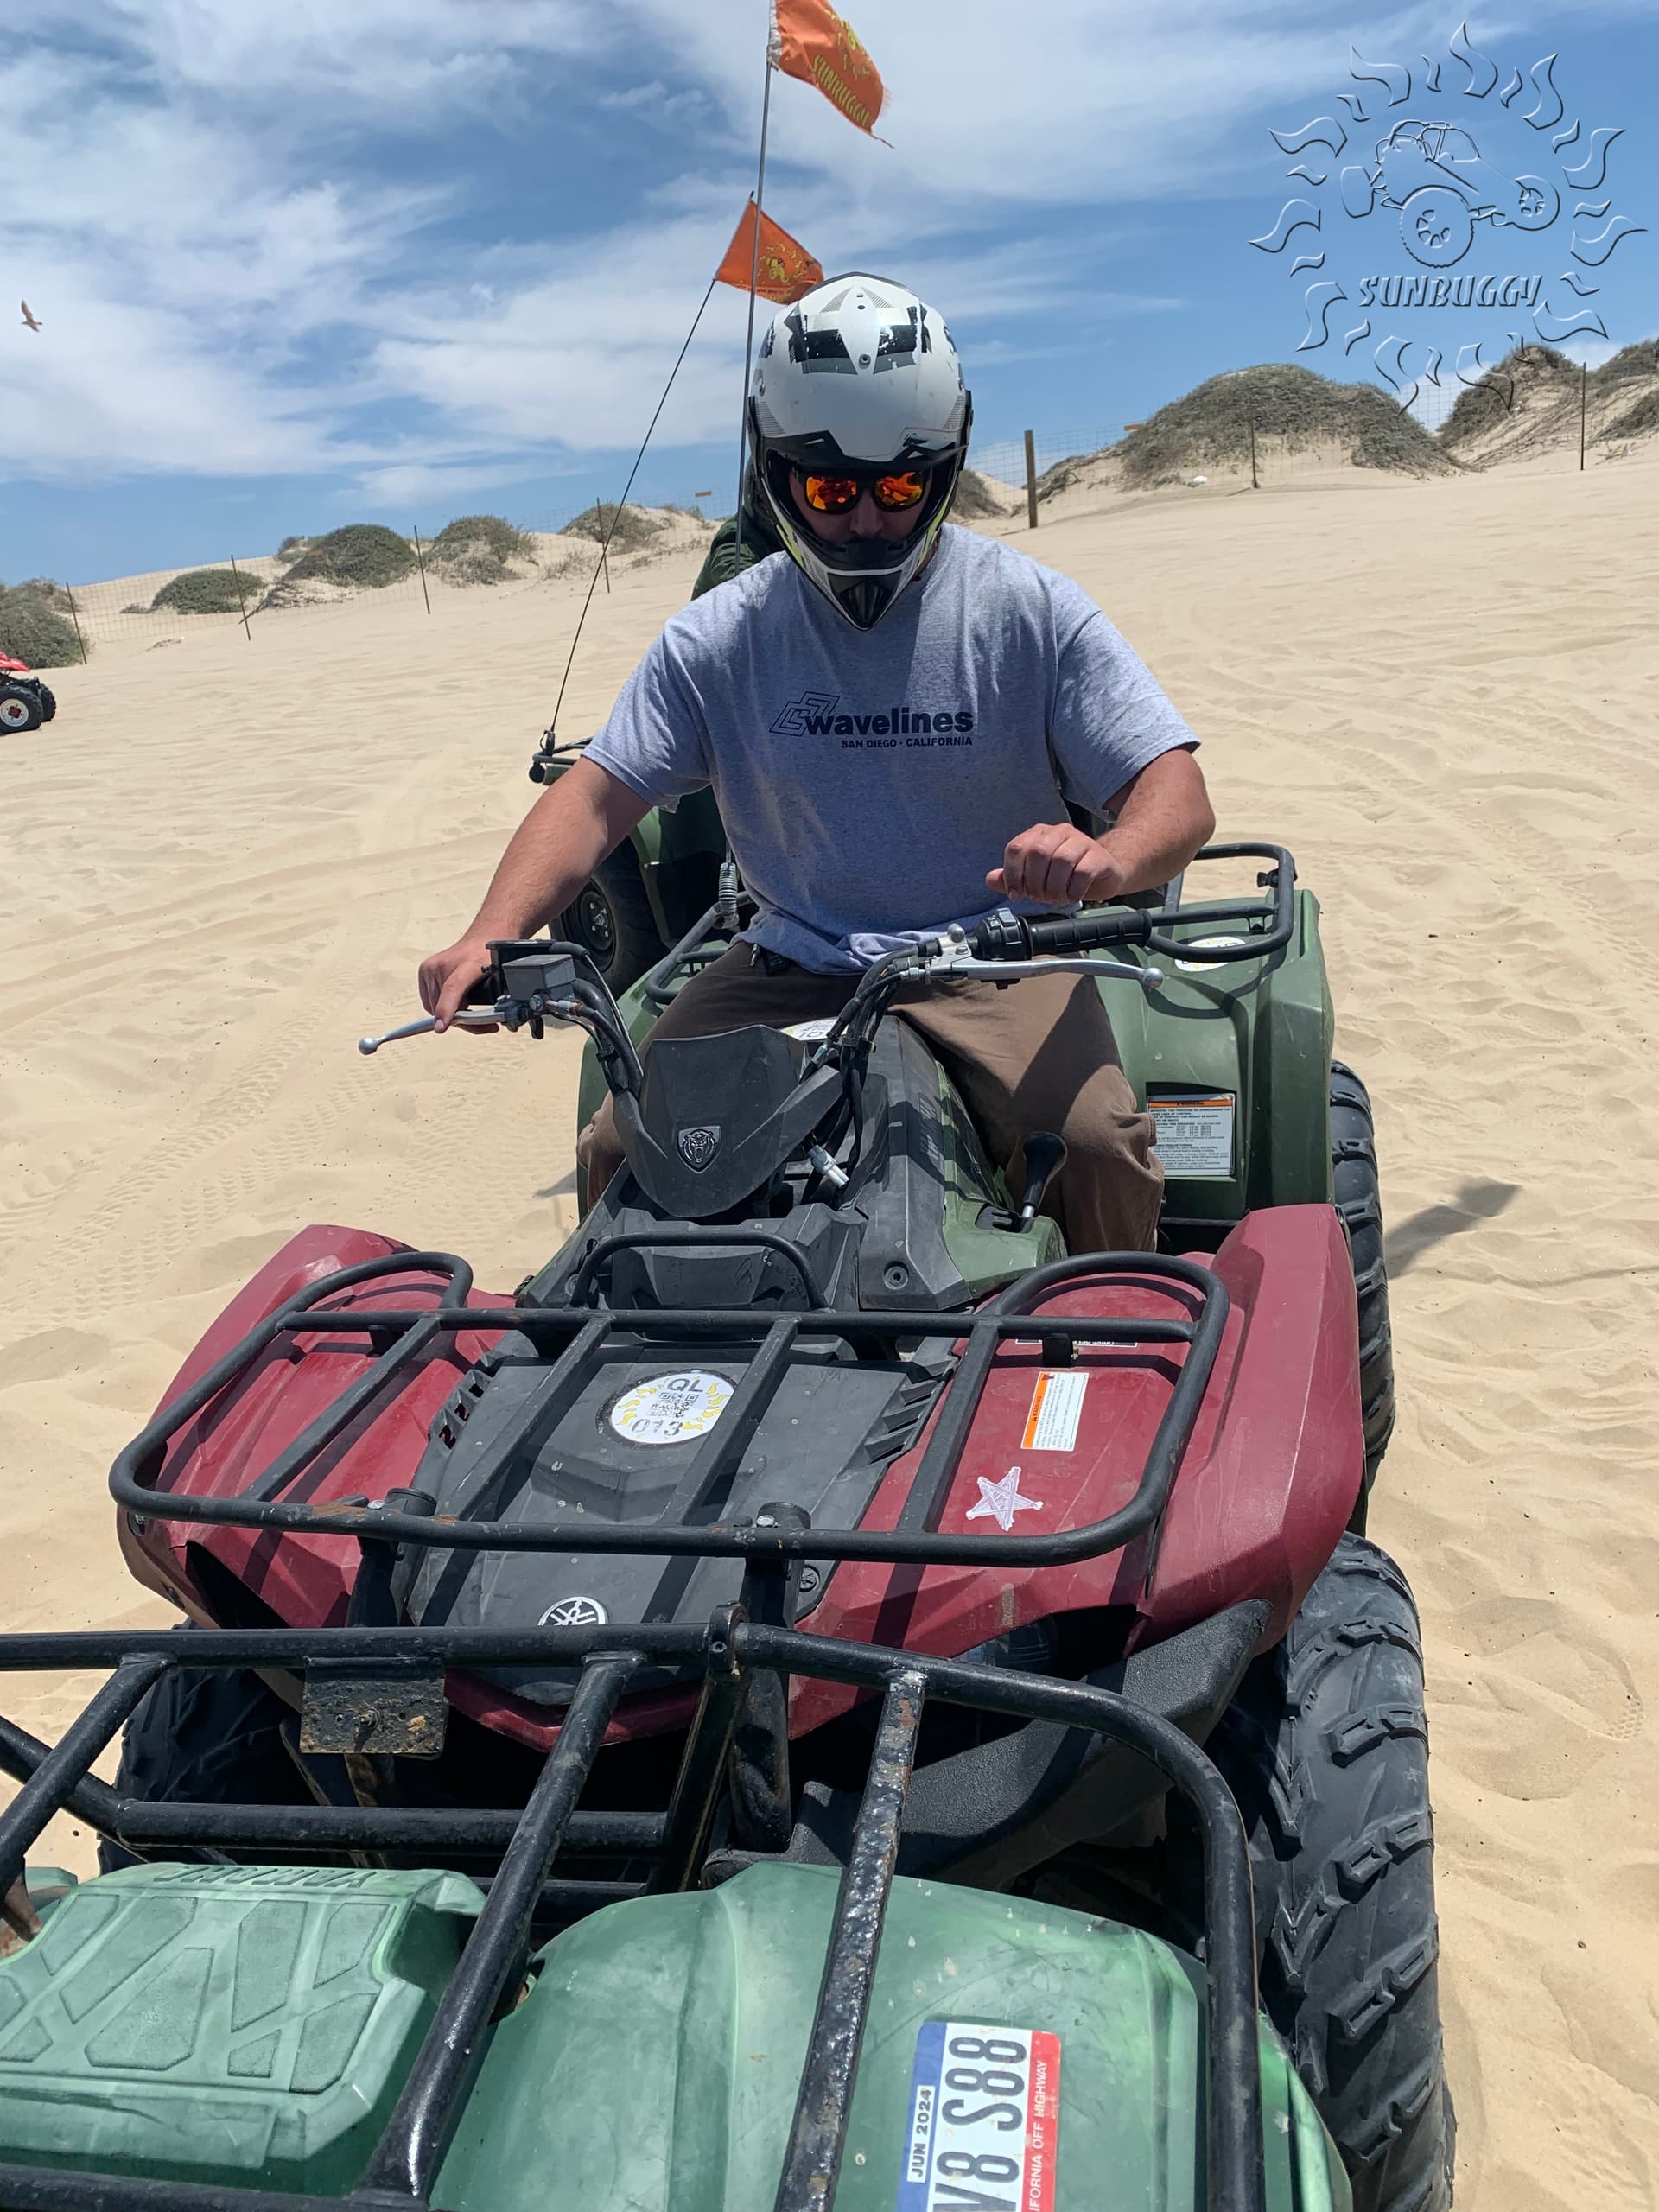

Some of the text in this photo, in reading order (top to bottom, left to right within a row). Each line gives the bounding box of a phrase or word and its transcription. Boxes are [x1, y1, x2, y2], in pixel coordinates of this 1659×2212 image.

[804, 708, 973, 735] wavelines
[842, 737, 973, 748] SAN DIEGO CALIFORNIA
[667, 1378, 704, 1393] QL
[632, 1418, 683, 1436] 013
[942, 2037, 1027, 2132] S88
[1034, 2060, 1048, 2118] HIGHWAY
[912, 2089, 932, 2177] JUN 2024
[1032, 2122, 1044, 2148] OFF
